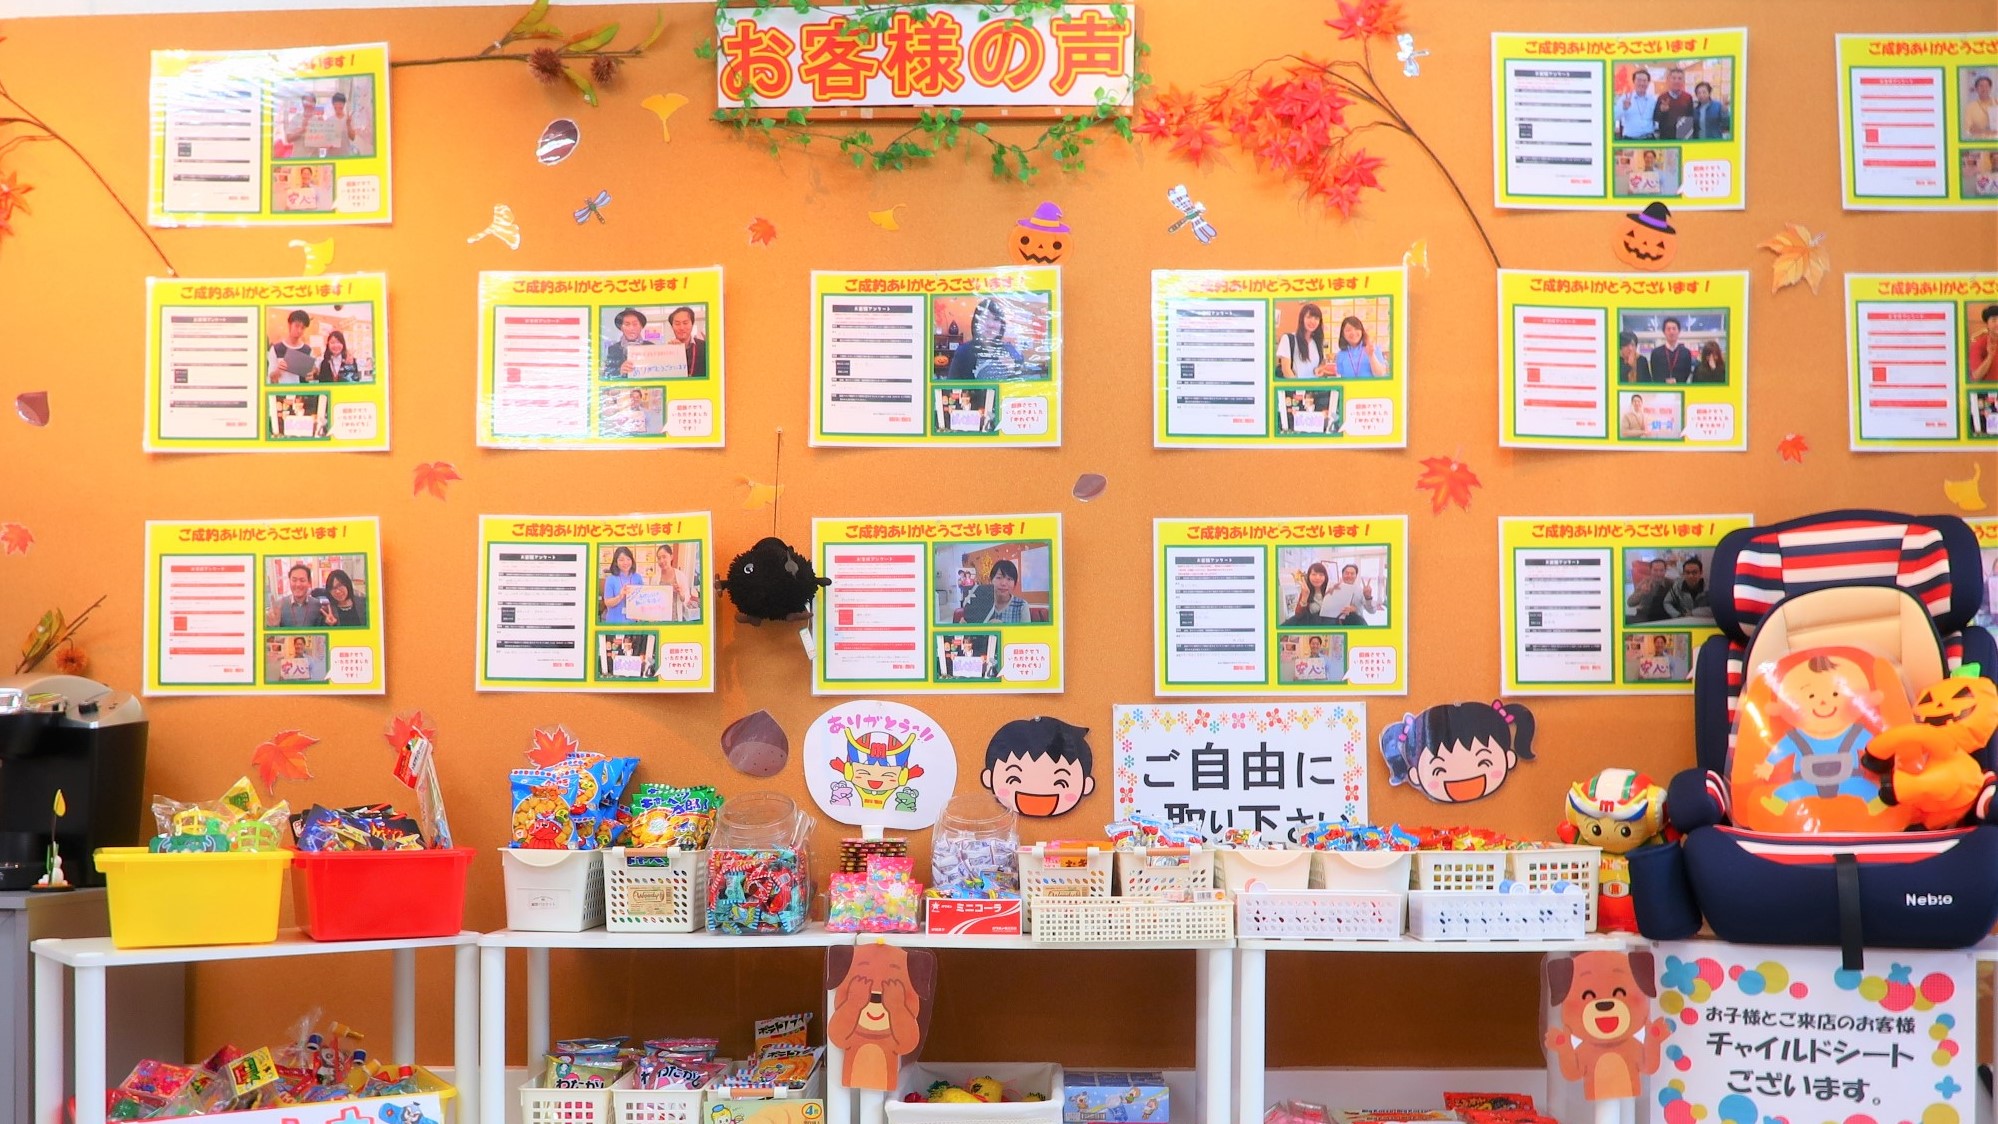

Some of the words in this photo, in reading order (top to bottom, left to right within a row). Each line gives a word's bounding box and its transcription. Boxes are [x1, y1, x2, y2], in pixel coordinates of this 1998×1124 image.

[1525, 37, 1709, 55] ご成約ありがとうございます！
[721, 10, 1131, 101] お客様の声
[512, 277, 689, 294] ご成約ありがとうございます！
[1530, 278, 1711, 294] ご成約ありがとうございます！
[1878, 280, 1998, 296] ご成約ありがとうご
[178, 525, 348, 542] ご成約ありがとうございます！
[512, 521, 682, 538] ご成約ありがとうございます！
[845, 522, 1026, 539] ご成約ありがとうございます！
[1187, 524, 1370, 540] ご成約ありがとうございます！
[1532, 523, 1715, 539] ご成約ありがとうございます！
[1143, 741, 1335, 791] ご自由に
[956, 903, 1002, 912] ミニコーラ
[1705, 1007, 1916, 1034] お子様とご来店のお客様
[1706, 1032, 1914, 1068] チャイルドシート
[1727, 1070, 1881, 1106] ございます。
